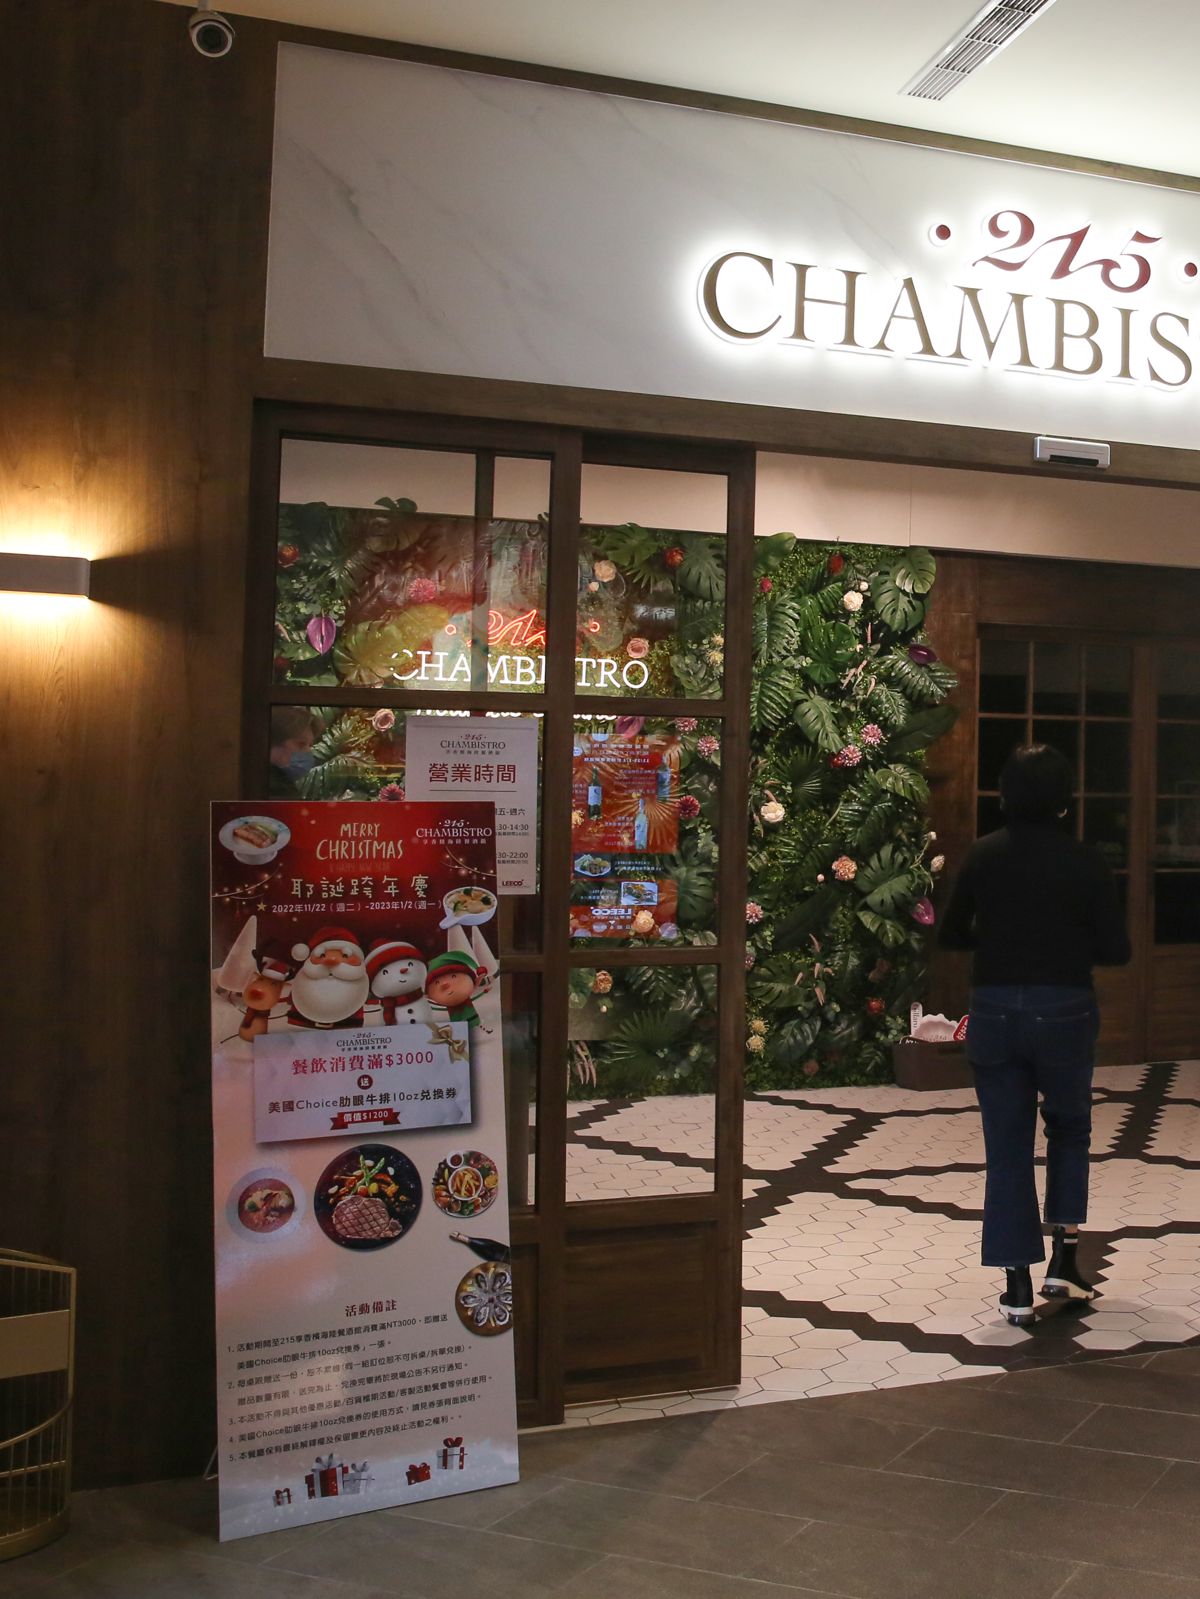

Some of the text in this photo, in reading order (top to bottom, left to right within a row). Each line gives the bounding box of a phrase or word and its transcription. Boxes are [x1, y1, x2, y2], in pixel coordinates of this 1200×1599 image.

[971, 209, 1165, 293] 215
[391, 648, 650, 690] CHAMBITRO
[440, 740, 506, 751] CHAMBISTRO
[428, 763, 517, 784] 營業時間
[340, 822, 381, 838] MERRY
[416, 827, 492, 838] CHAMBISTRO
[315, 839, 405, 861] CHRISTMAS
[291, 874, 430, 899] 耶誕跨年慶
[502, 879, 524, 887] LEECO
[336, 1037, 392, 1048] CHAMBISTRO
[291, 1050, 434, 1075] 餐飲消費滿$3000
[344, 1298, 398, 1318] 活動備註
